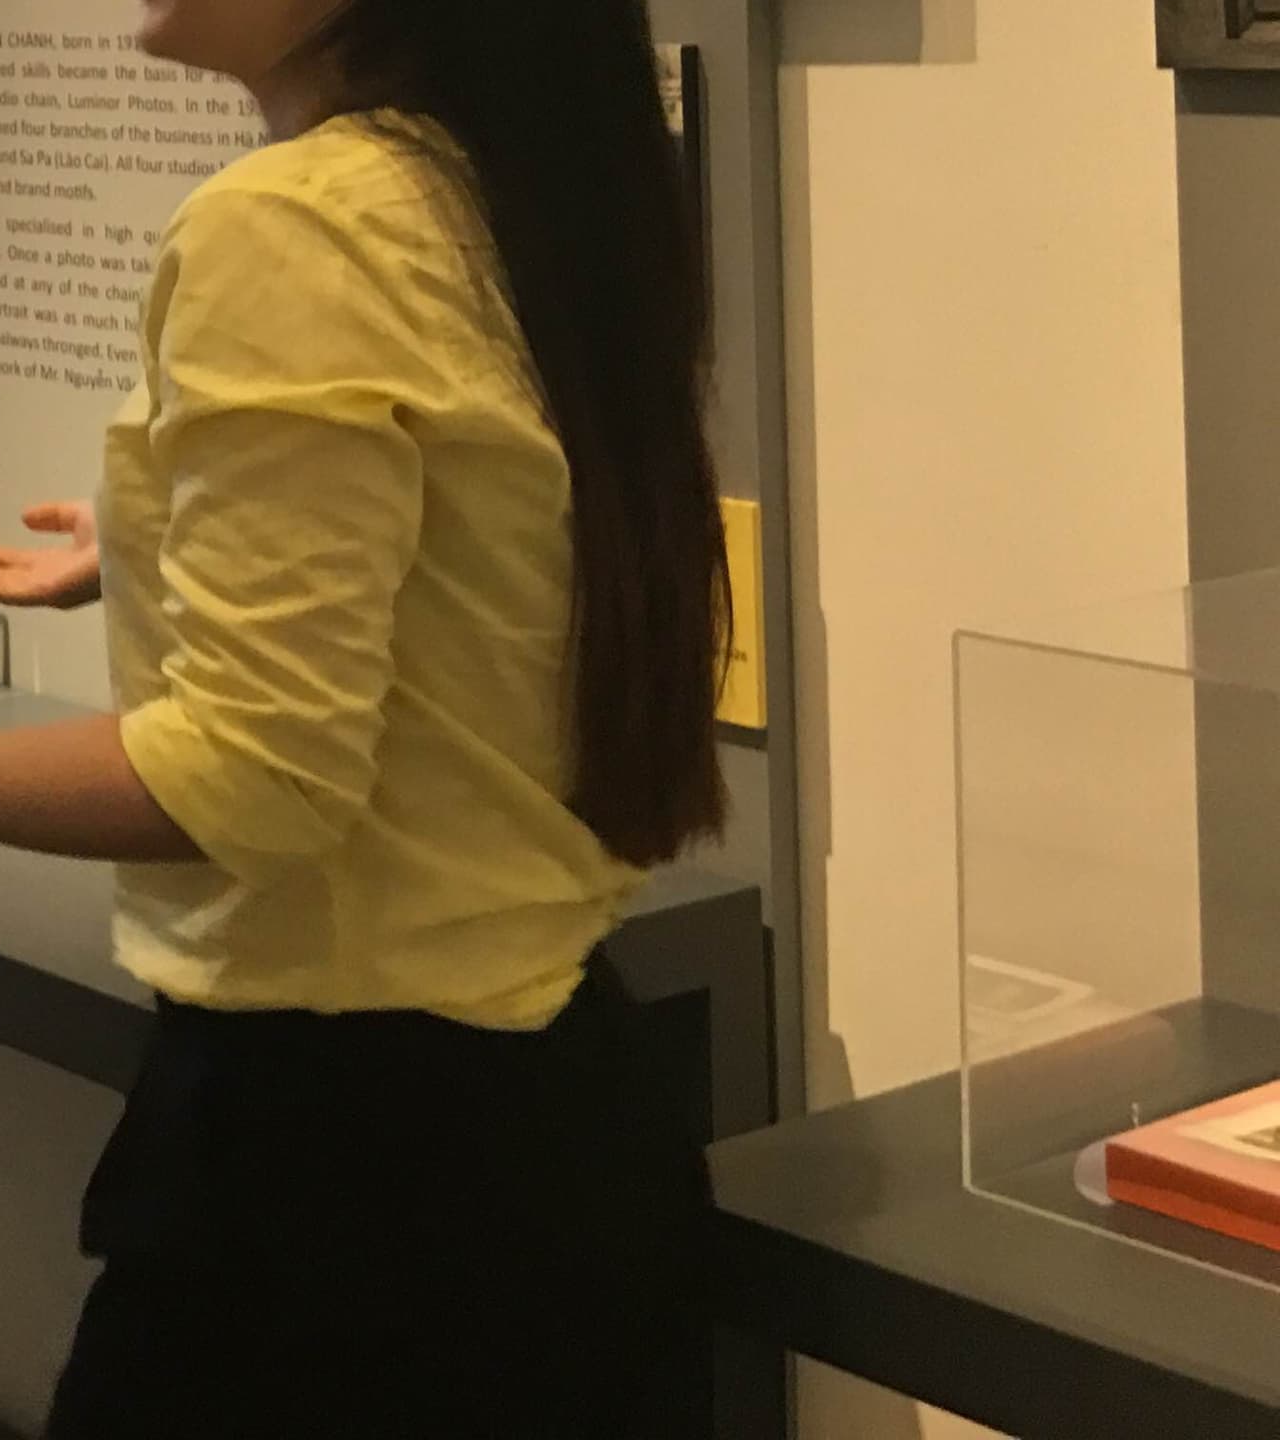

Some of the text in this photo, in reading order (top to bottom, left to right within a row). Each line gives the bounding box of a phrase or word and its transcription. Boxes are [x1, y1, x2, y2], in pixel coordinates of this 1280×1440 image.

[21, 119, 46, 137] four
[50, 121, 108, 140] branches
[111, 124, 125, 142] of
[128, 125, 151, 143] the
[154, 126, 213, 146] business
[217, 132, 230, 146] in
[57, 250, 126, 271] photo was
[59, 279, 99, 299] of the
